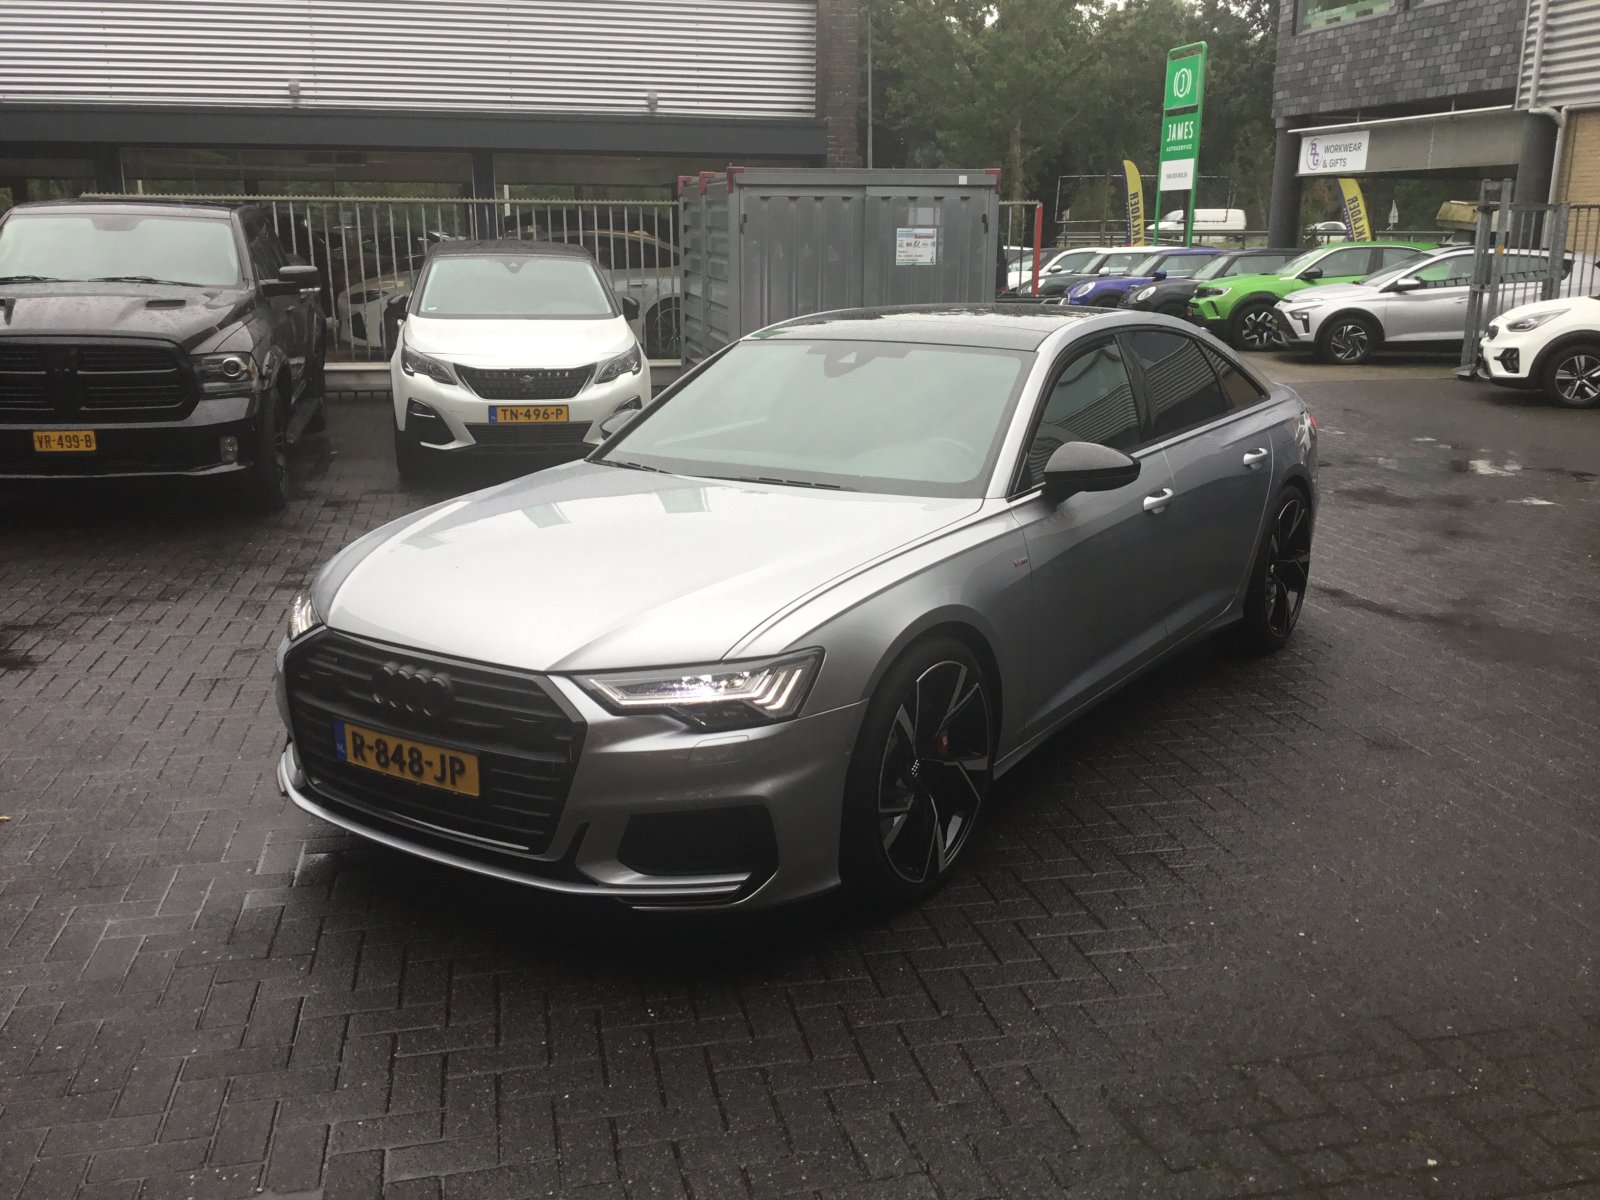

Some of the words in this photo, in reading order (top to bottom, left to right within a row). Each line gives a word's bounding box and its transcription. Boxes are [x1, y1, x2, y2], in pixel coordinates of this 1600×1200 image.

[1166, 120, 1194, 142] JAMES
[1324, 142, 1362, 154] WORKWEAR
[1322, 159, 1327, 168] &
[1329, 157, 1347, 168] GIFTS
[501, 408, 563, 420] TN-496-P
[37, 434, 92, 449] VR-499-B
[351, 731, 466, 786] R-848-JP
